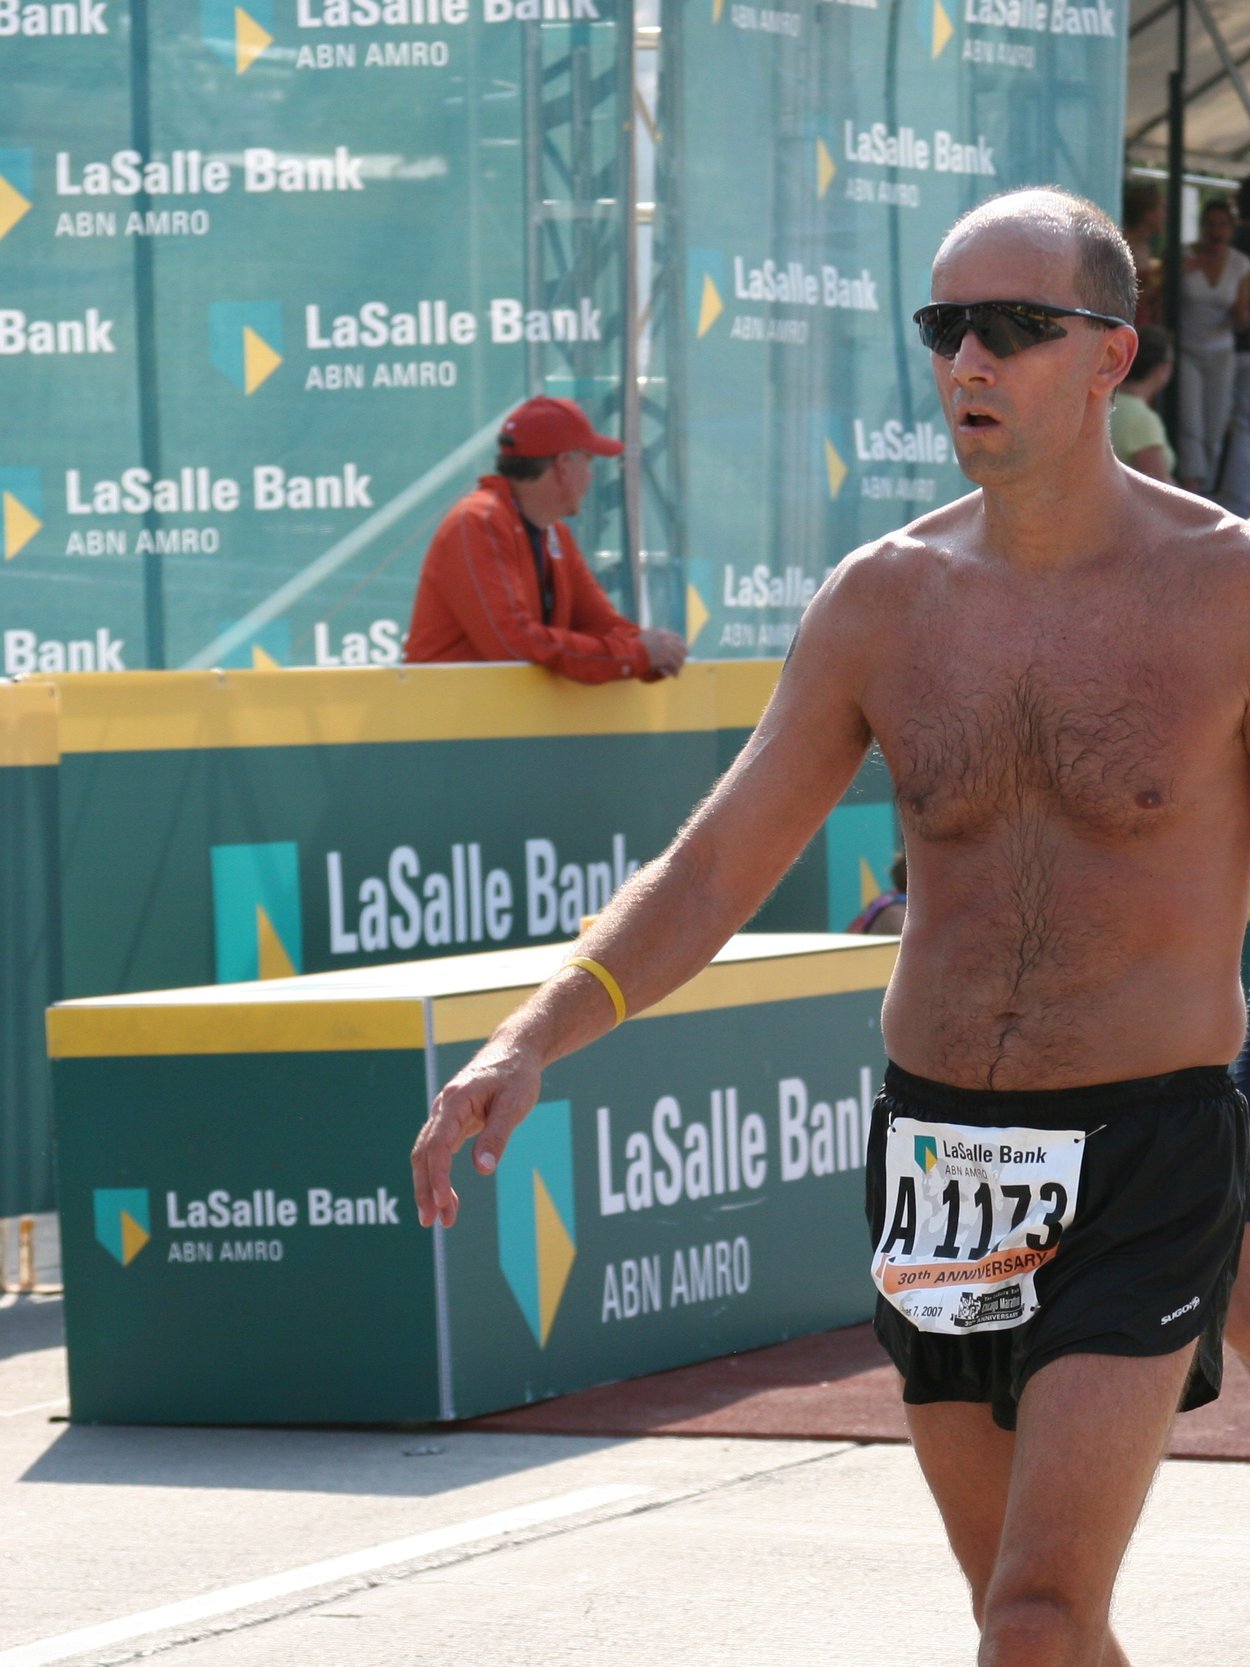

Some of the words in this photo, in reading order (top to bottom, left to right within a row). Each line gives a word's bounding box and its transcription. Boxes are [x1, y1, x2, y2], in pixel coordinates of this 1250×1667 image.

[1050, 0, 1115, 37] Bank
[296, 42, 356, 70] ABN
[364, 41, 450, 68] AMRO
[844, 119, 930, 171] LaSalle
[934, 130, 996, 176] Bank
[55, 151, 230, 196] LaSalle
[243, 147, 364, 192] Bank
[54, 211, 117, 238] ABN
[124, 209, 210, 236] AMRO
[733, 255, 819, 307] LaSalle
[822, 263, 879, 312] Bank
[0, 309, 115, 354] Bank
[305, 302, 477, 350] LaSalle
[490, 298, 600, 345] Bank
[304, 364, 364, 391] ABN
[371, 361, 458, 388] AMRO
[853, 418, 949, 464] LaSalle
[65, 467, 240, 514] LaSalle
[253, 463, 373, 512] Bank
[66, 531, 127, 556] ABN
[135, 527, 220, 555] AMRO
[723, 564, 816, 608] LaSalle
[3, 627, 126, 674] Bank
[314, 619, 407, 668] LaS
[326, 843, 513, 954] LaSalle
[597, 1087, 767, 1216] LaSalle
[943, 1140, 993, 1164] LaSalle
[999, 1145, 1046, 1165] Bank
[945, 1164, 963, 1177] ABN
[166, 1189, 298, 1229] LaSalle
[307, 1187, 400, 1227] Bank
[881, 1176, 918, 1255] A
[933, 1179, 1069, 1260] 1173
[167, 1241, 214, 1263] ABN
[219, 1239, 283, 1262] AMRO
[897, 1270, 931, 1285] 30th
[934, 1251, 1048, 1283] ANNIVERSARY
[601, 1252, 663, 1323] ABN
[670, 1235, 751, 1308] AMRO
[921, 1306, 943, 1317] 2007
